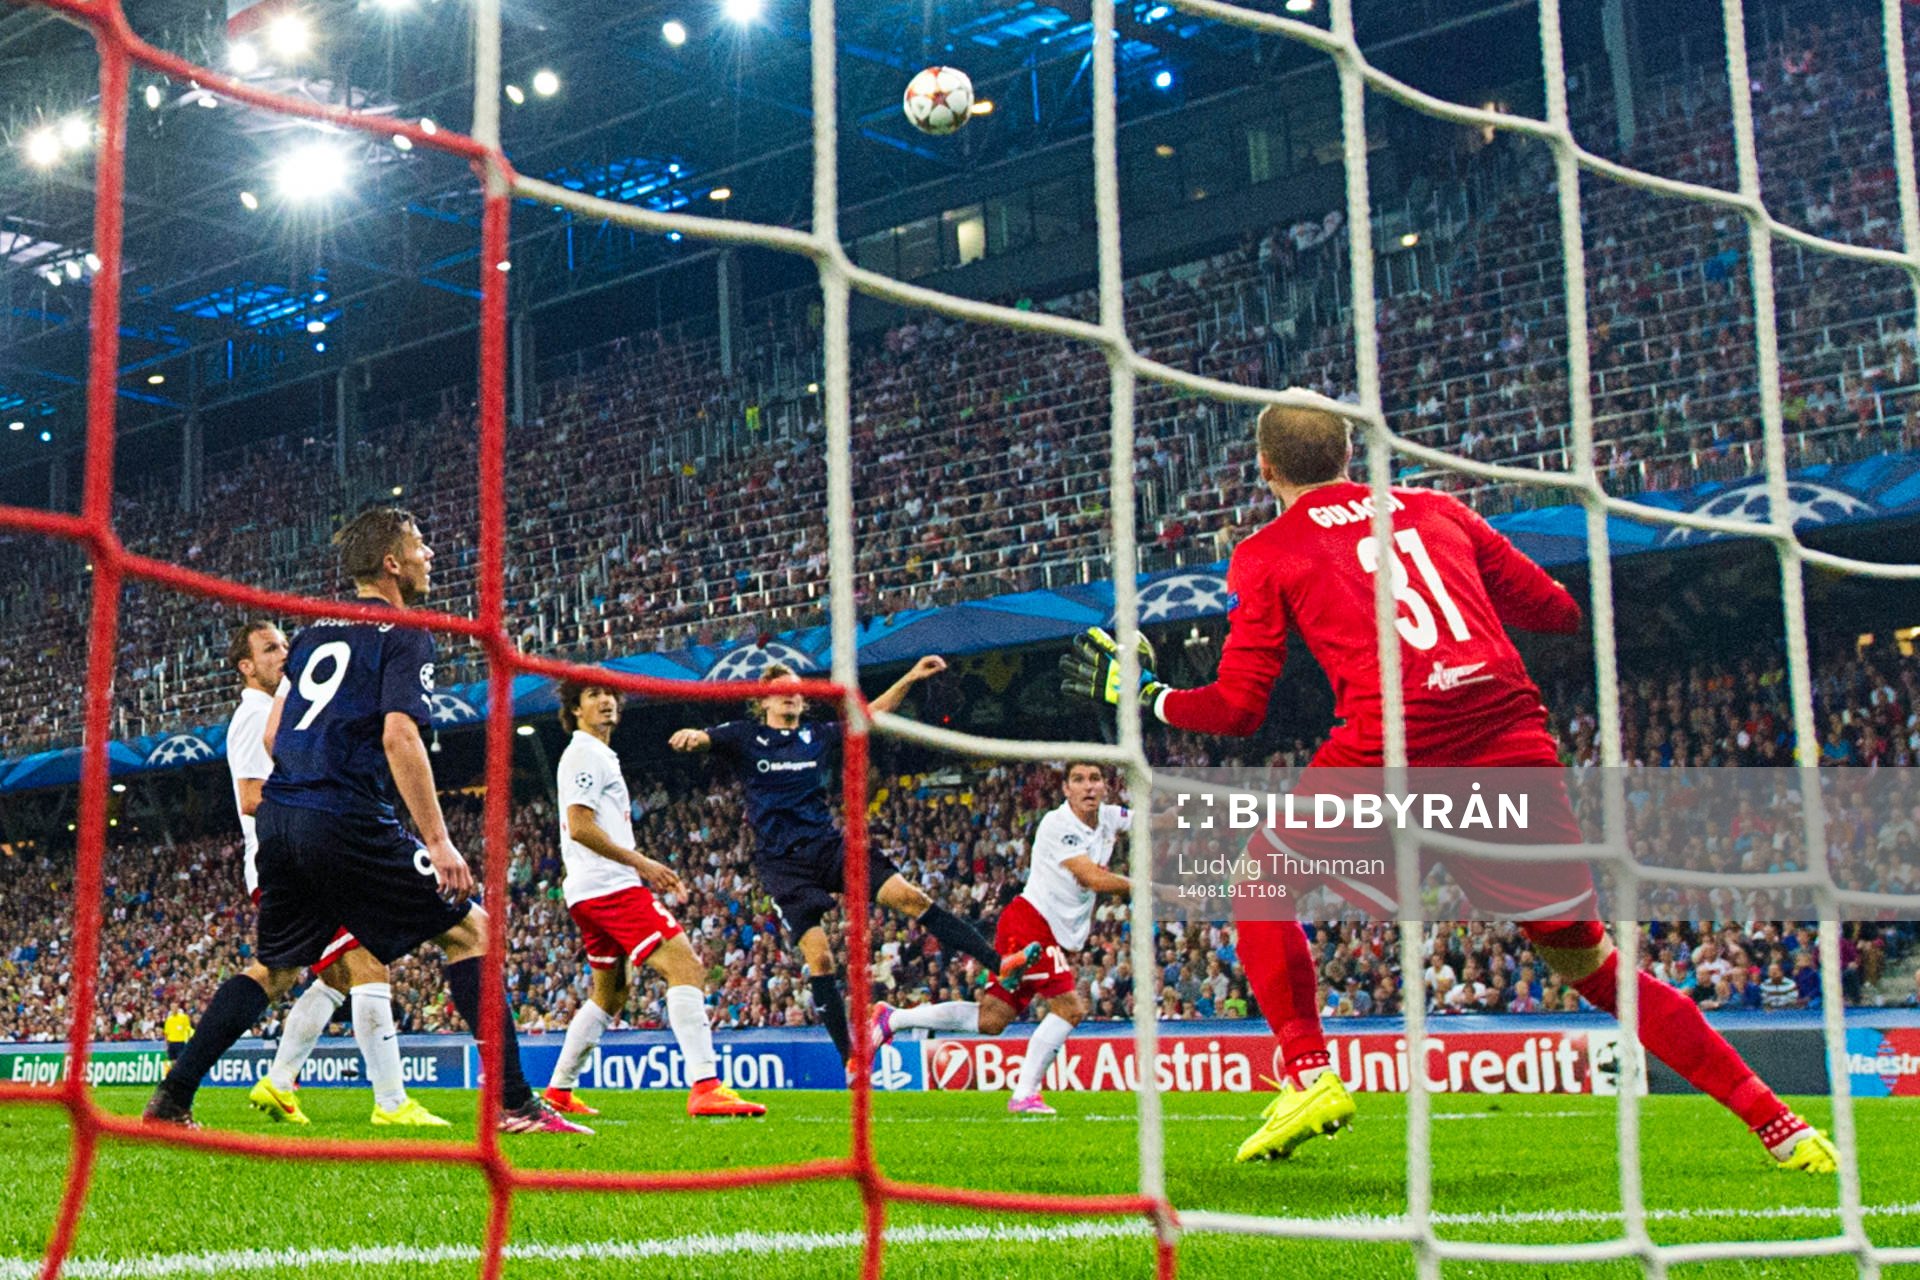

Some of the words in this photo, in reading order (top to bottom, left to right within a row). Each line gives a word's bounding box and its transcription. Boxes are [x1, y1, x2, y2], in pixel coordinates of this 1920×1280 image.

[1357, 528, 1472, 650] 31
[294, 641, 351, 731] 9
[11, 1056, 60, 1087] Enjoy
[63, 1053, 170, 1087] Rsponsibly
[210, 1058, 250, 1082] UEFA
[1327, 1037, 1582, 1093] UniCredit
